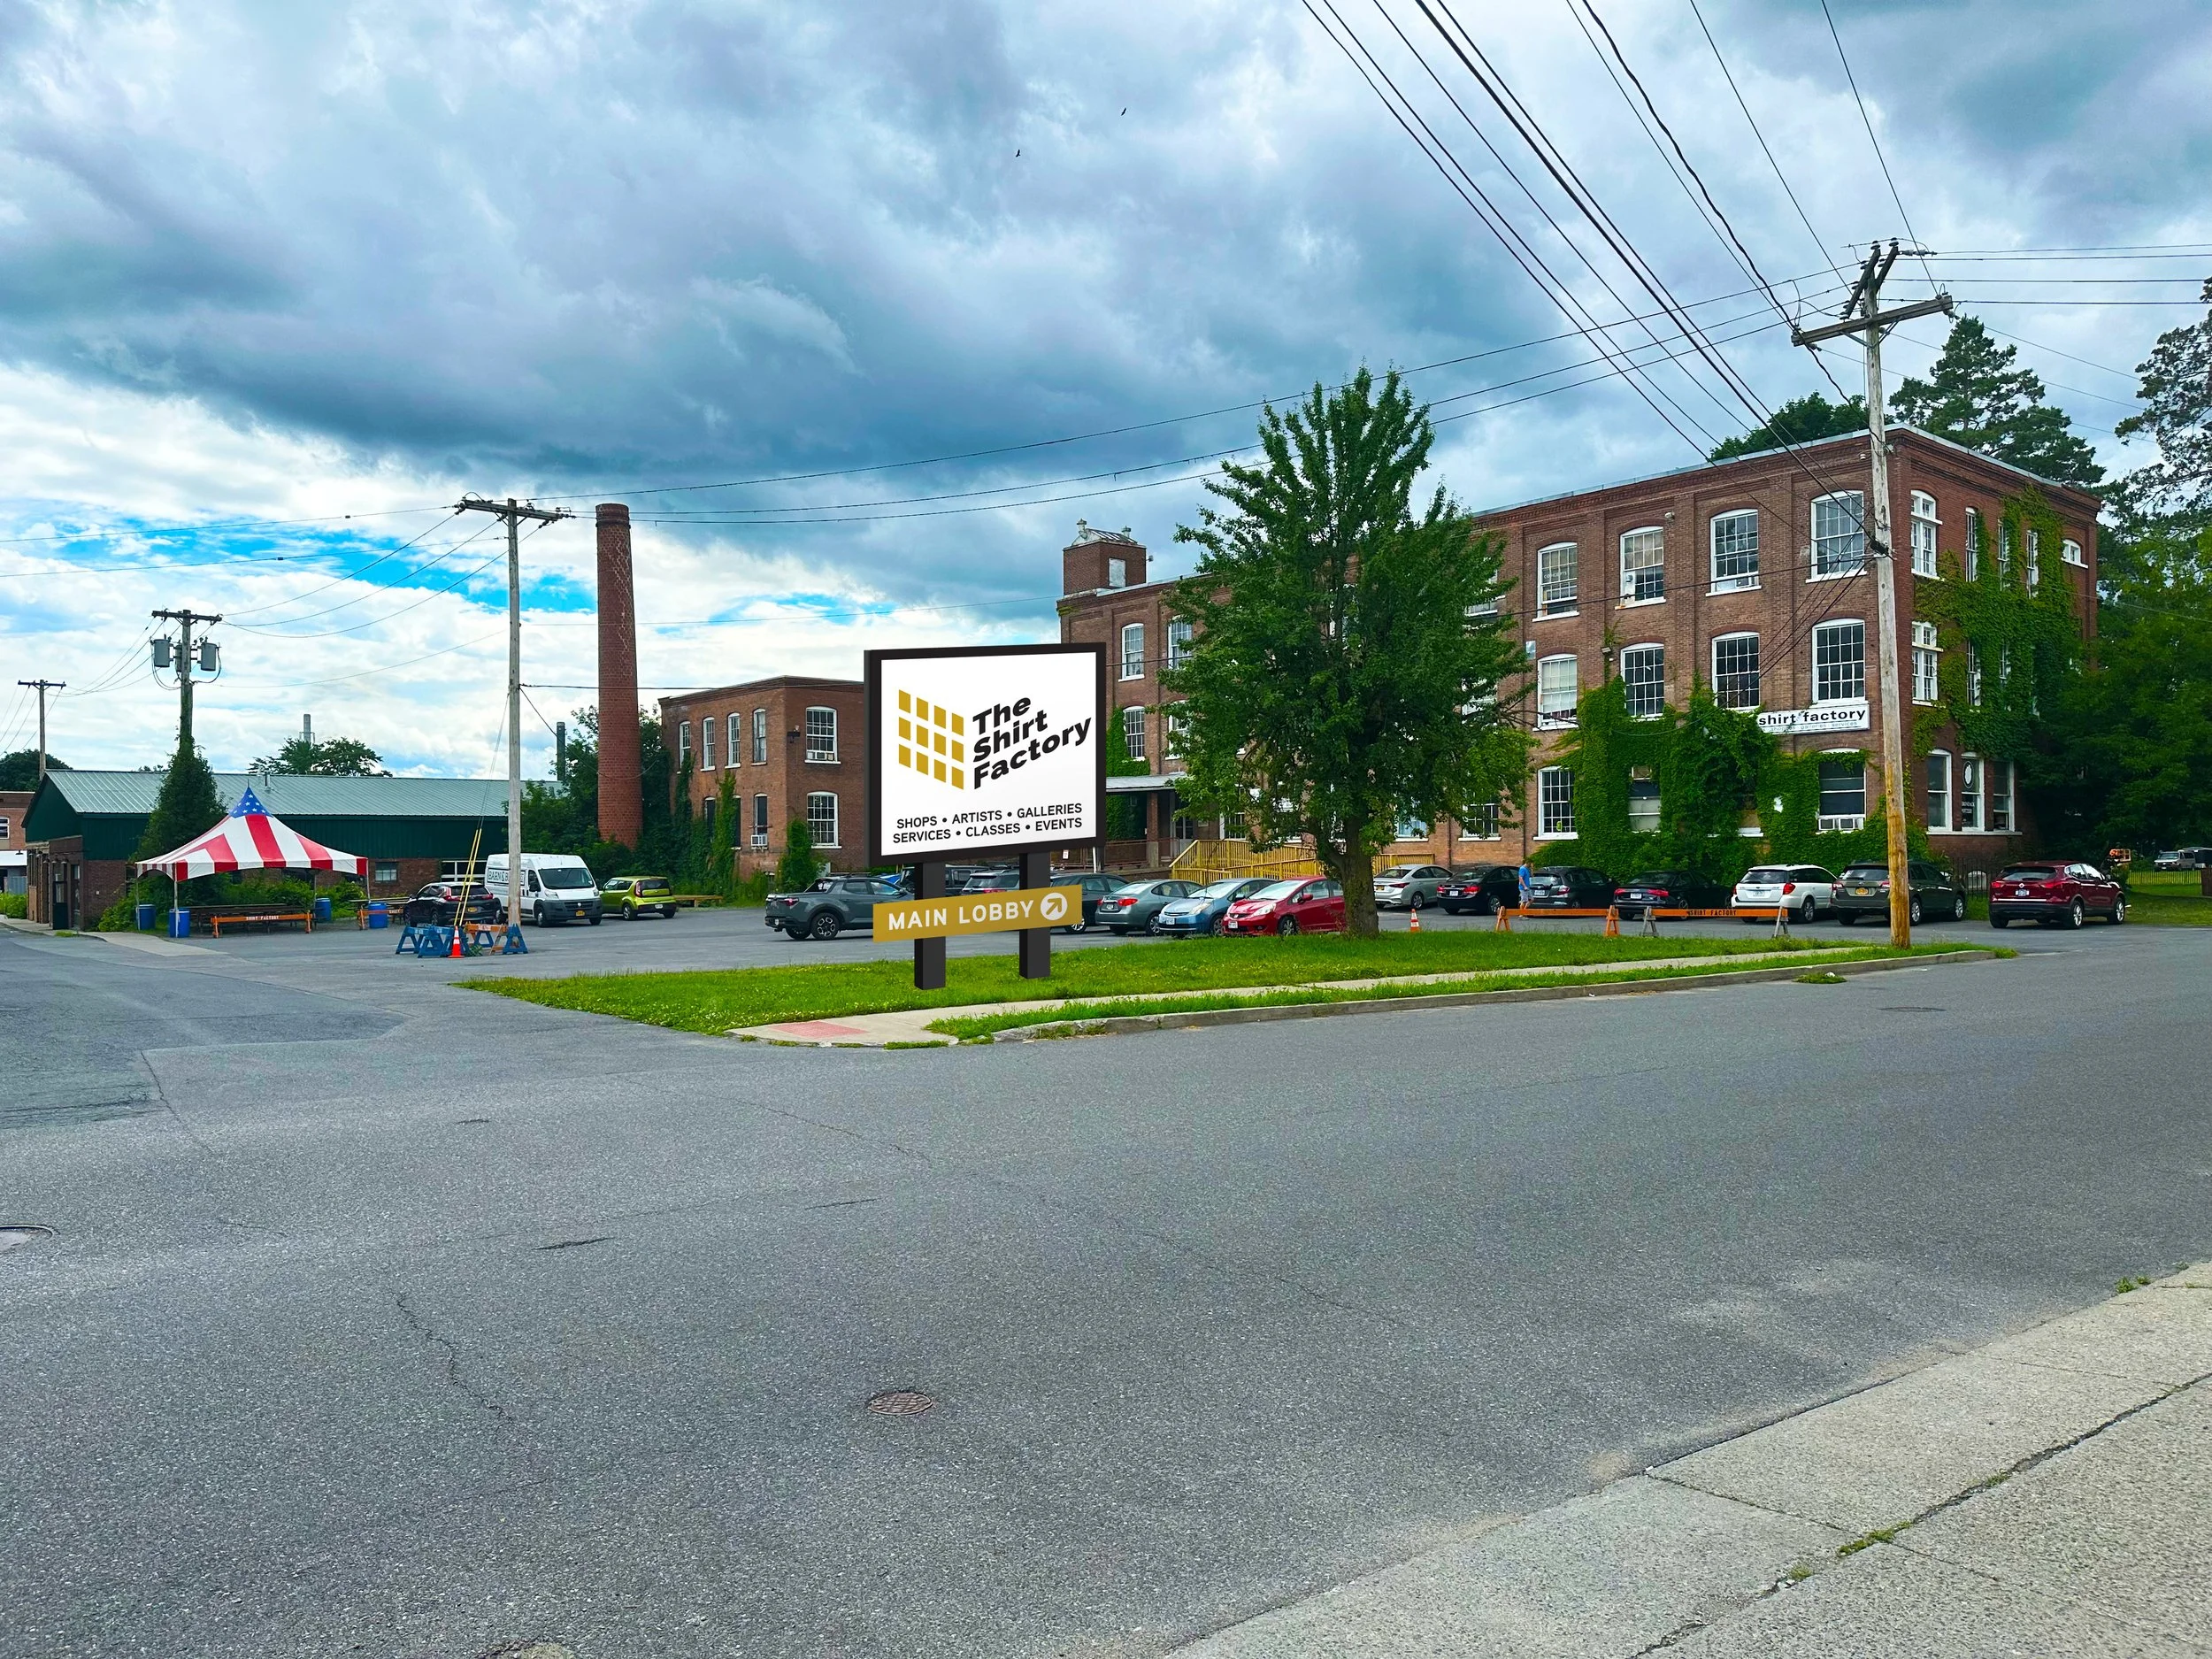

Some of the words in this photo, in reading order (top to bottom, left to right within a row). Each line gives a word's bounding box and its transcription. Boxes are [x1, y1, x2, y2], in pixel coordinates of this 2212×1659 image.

[972, 697, 1032, 735] The
[1758, 713, 1796, 726] shirt
[1802, 710, 1866, 722] factory
[972, 710, 1048, 763] Shirt
[974, 717, 1092, 790] Factory
[893, 828, 951, 844] SERVICES
[965, 823, 1021, 837] CLASSES
[1035, 817, 1082, 832] EVENTS
[896, 816, 938, 829] SHOPS
[952, 810, 1002, 825] ARTISTS
[1017, 803, 1082, 818] GALLERIES
[888, 908, 948, 931] MAIN
[959, 900, 1034, 925] LOBBY
